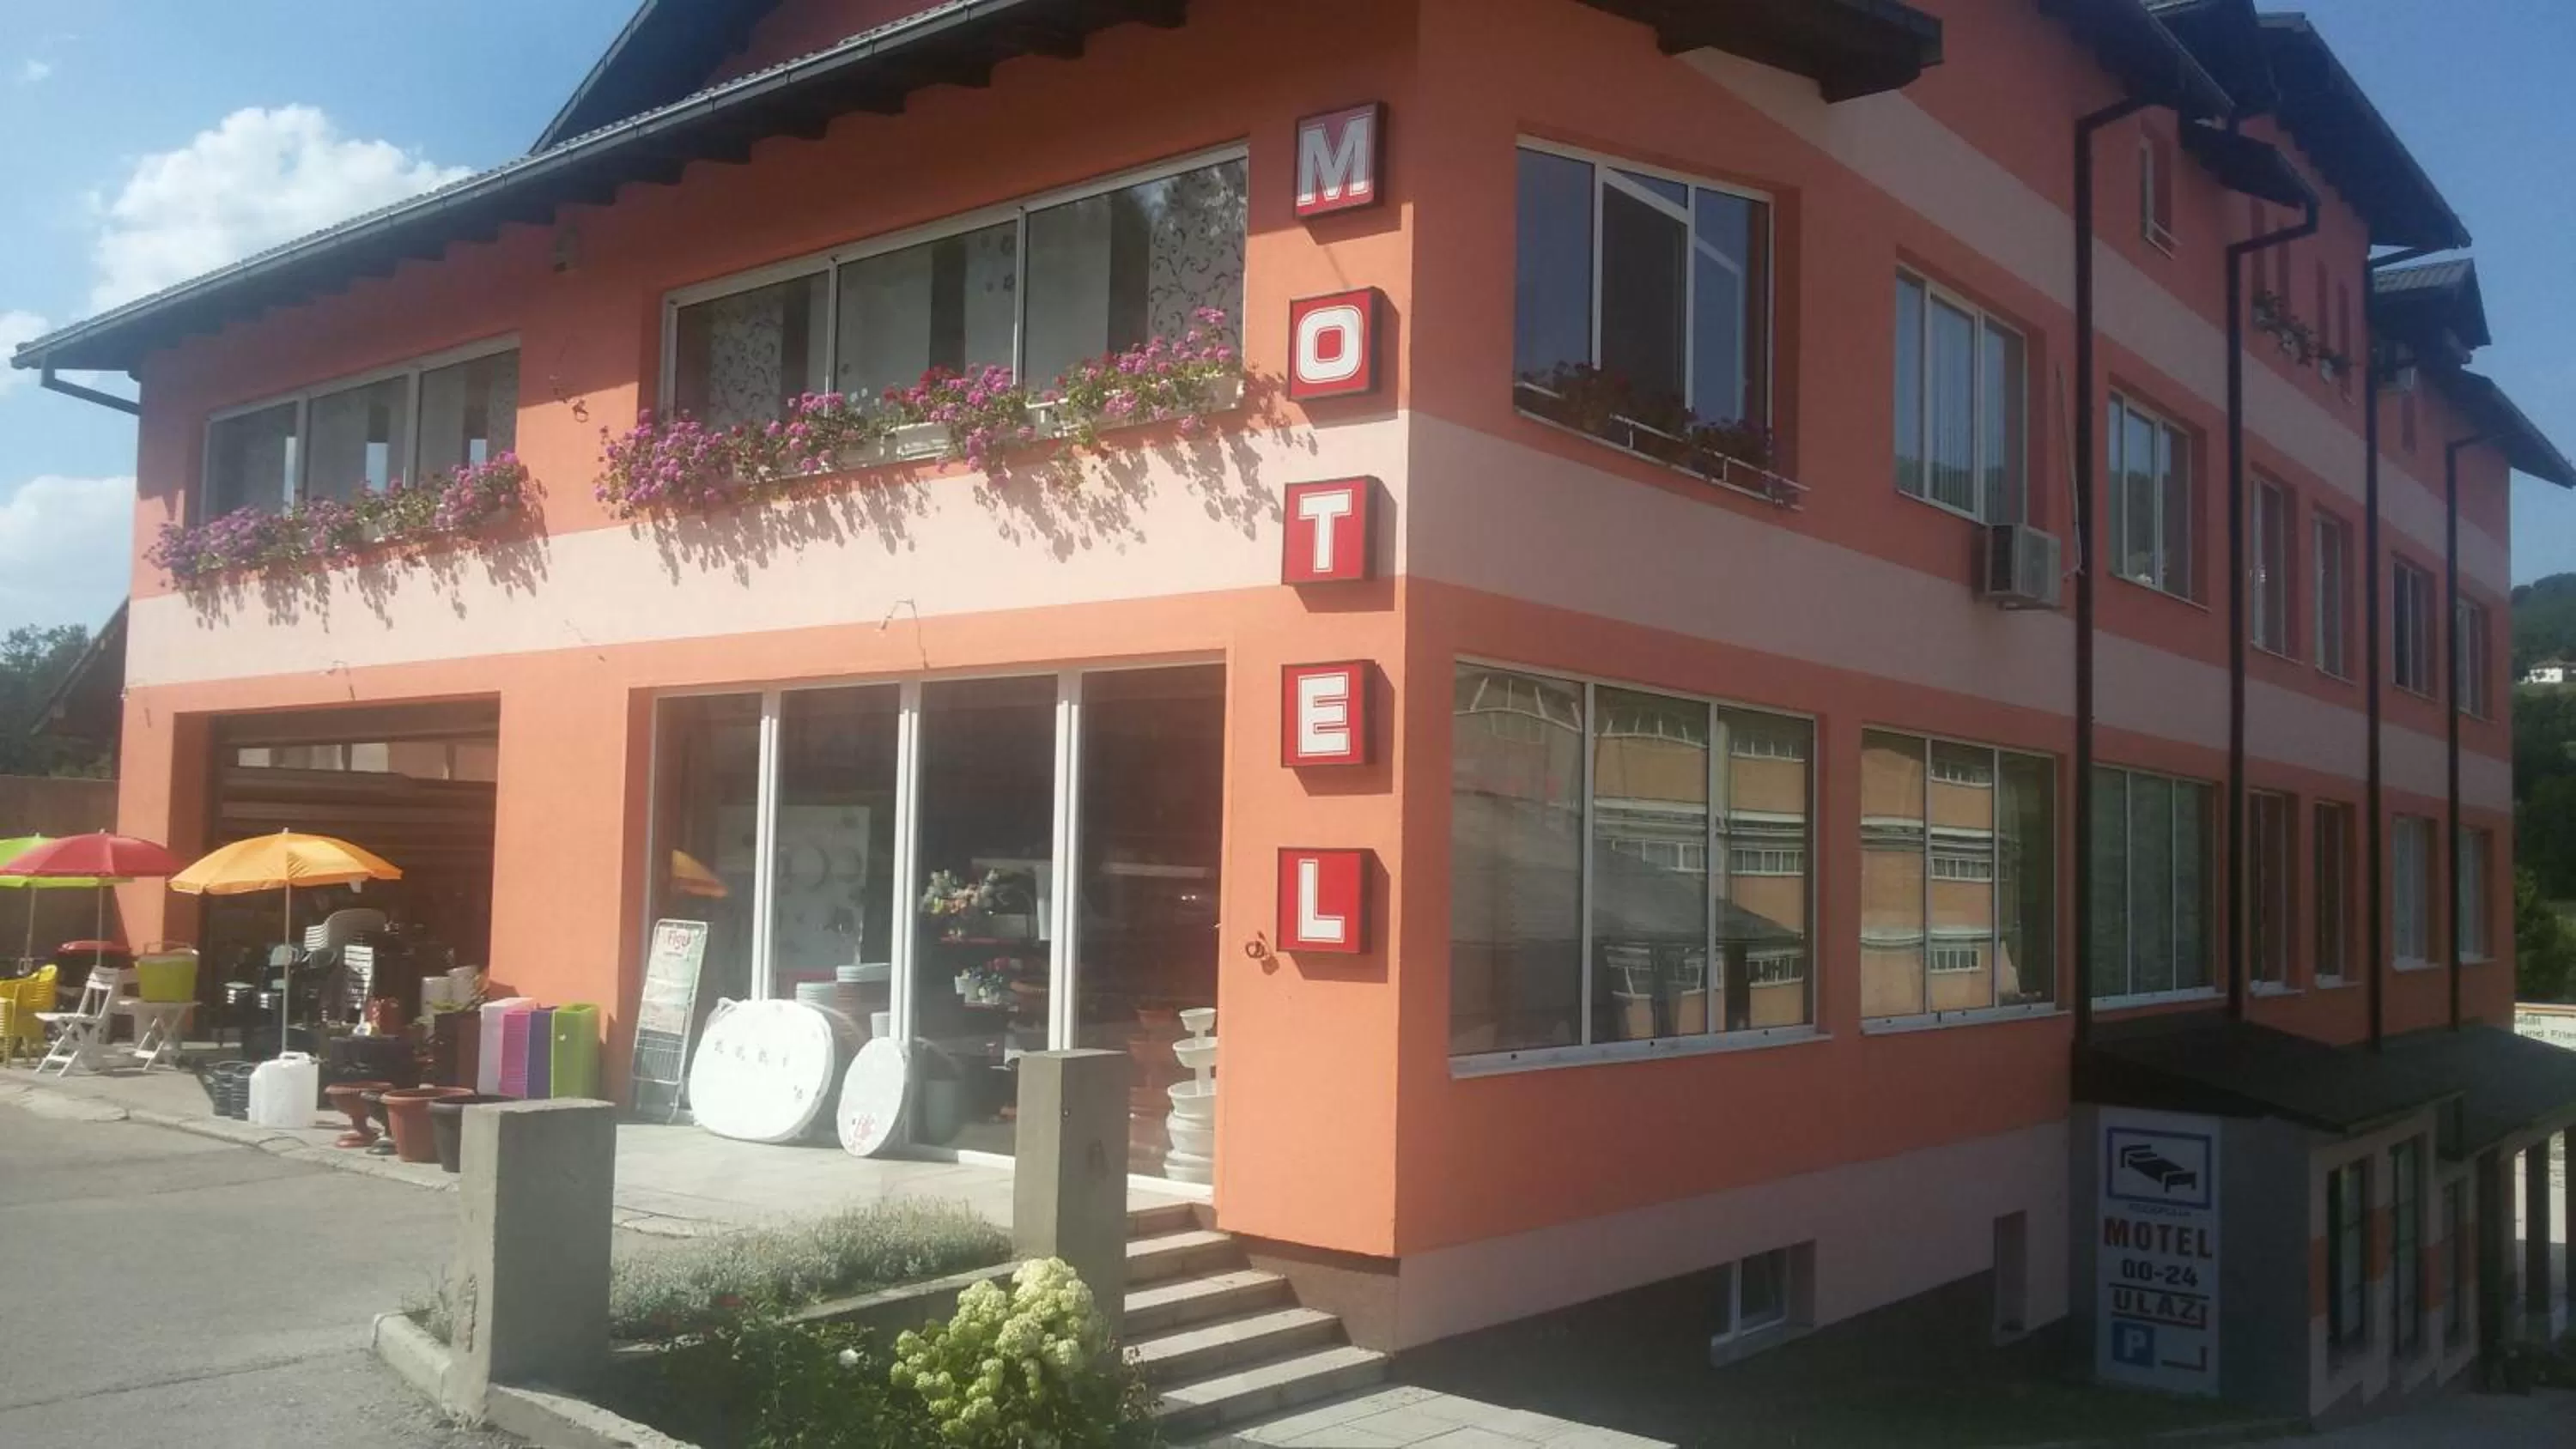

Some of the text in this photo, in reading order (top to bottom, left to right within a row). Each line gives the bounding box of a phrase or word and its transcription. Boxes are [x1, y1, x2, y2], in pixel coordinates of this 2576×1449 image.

[1297, 112, 1373, 943] MOTEL
[2104, 1216, 2213, 1258] MOTEL
[2122, 1258, 2198, 1287] 00-24
[2113, 1289, 2199, 1319] ULAZ
[2123, 1328, 2146, 1358] P
